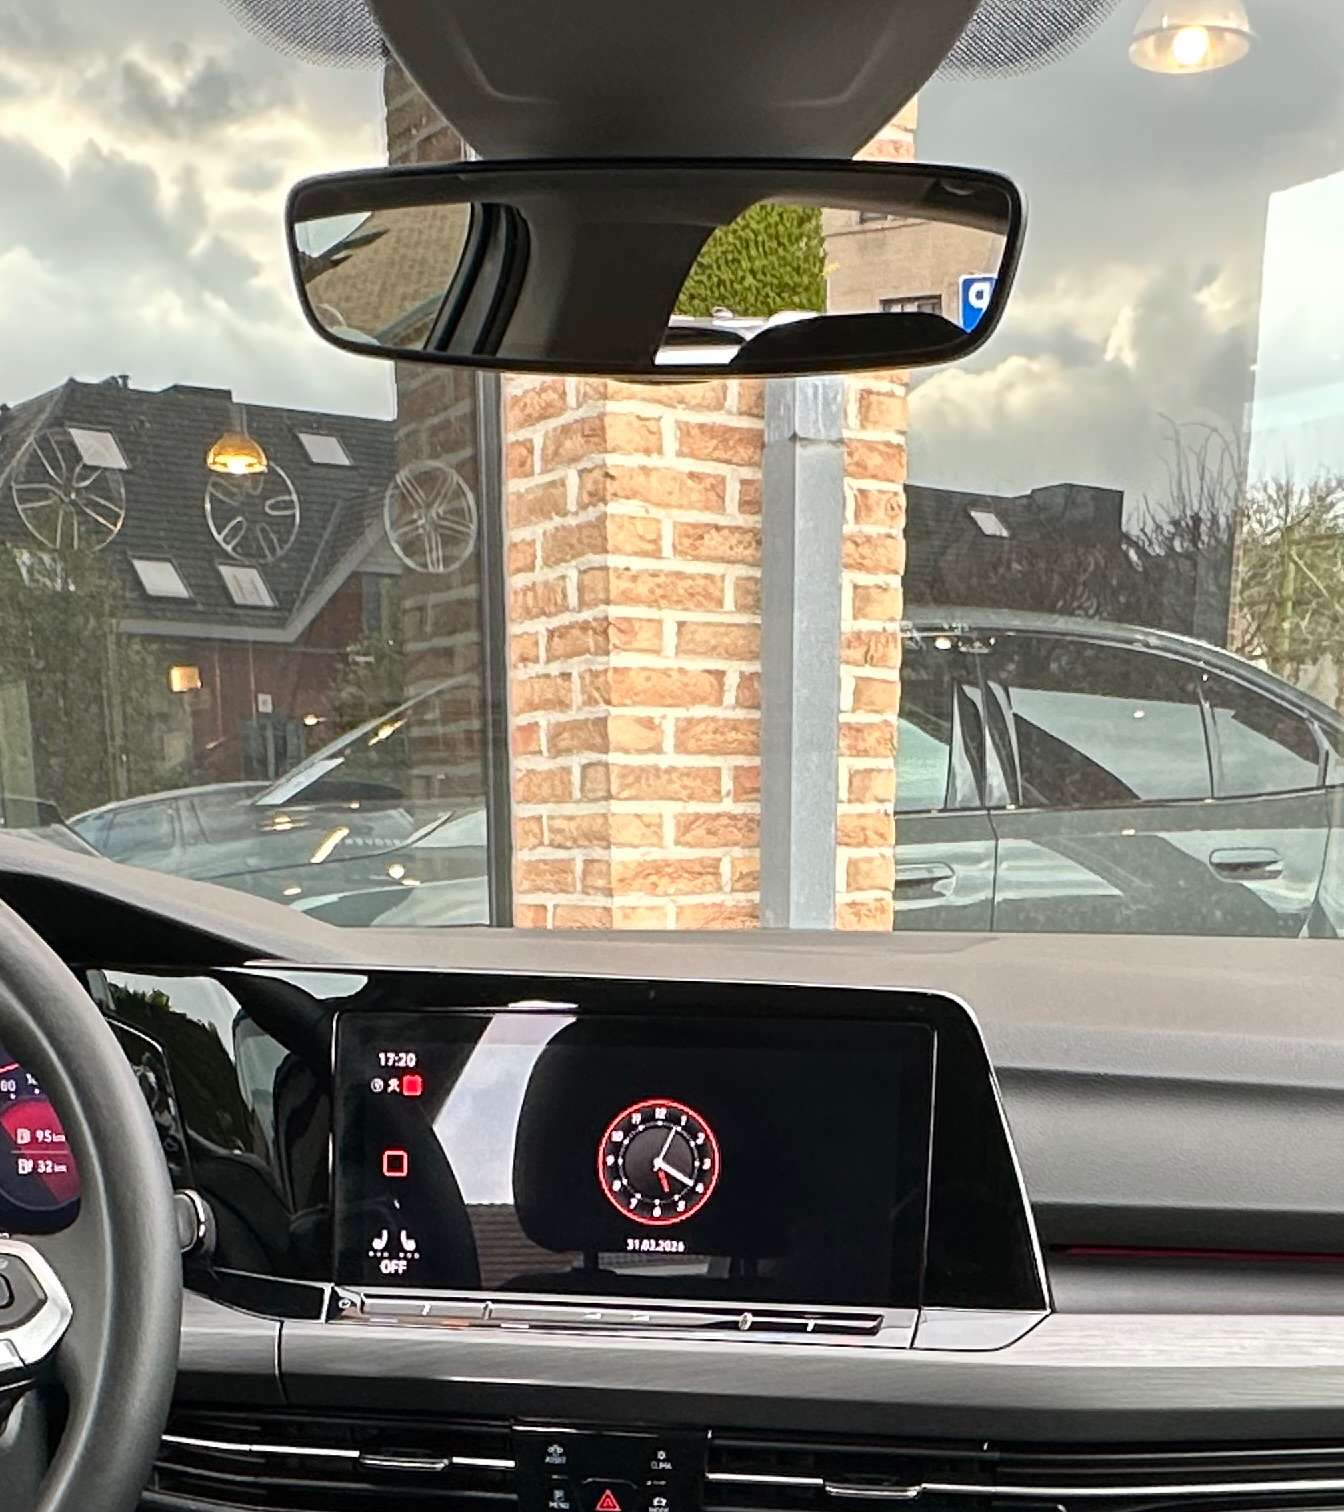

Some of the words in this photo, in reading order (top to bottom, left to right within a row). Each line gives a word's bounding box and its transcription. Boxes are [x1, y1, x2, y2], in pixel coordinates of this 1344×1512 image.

[378, 1052, 416, 1067] 17:20
[36, 1129, 52, 1142] 95
[37, 1160, 53, 1172] 32
[379, 1260, 407, 1273] OFF
